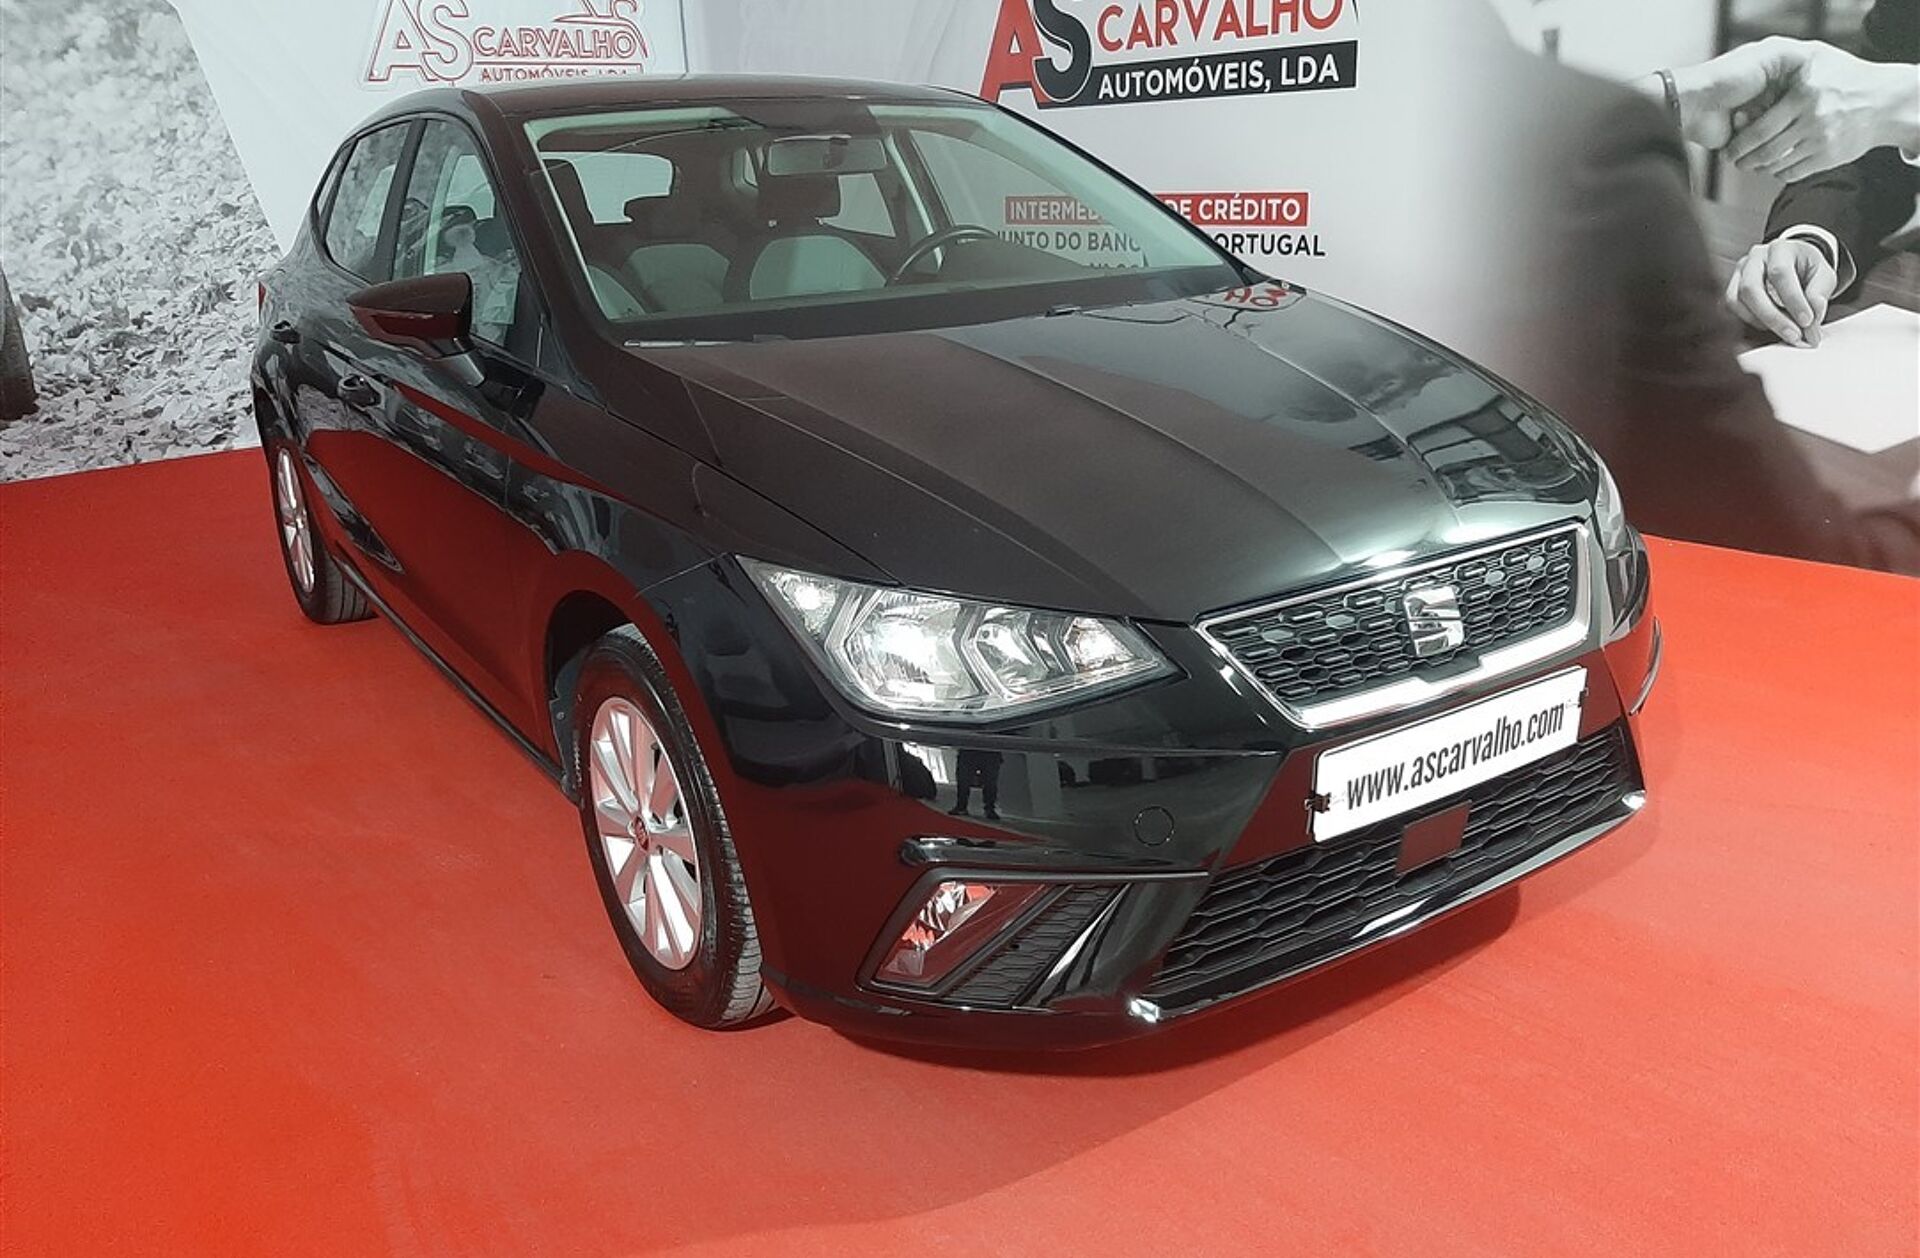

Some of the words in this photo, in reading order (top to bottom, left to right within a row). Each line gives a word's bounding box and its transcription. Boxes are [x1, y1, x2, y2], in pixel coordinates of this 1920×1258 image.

[369, 0, 473, 81] AS
[473, 27, 637, 58] CARVALHO
[980, 0, 1091, 103] AS
[1097, 0, 1343, 51] CARVALHO
[1098, 58, 1271, 99] AUTOMÓVEIS,
[1281, 53, 1340, 86] LDA
[1198, 193, 1300, 221] CRÉDITO
[1055, 231, 1082, 250] DO
[1088, 232, 1141, 252] BANC
[1213, 233, 1326, 256] ORTUGAL
[1346, 702, 1565, 811] www.ascarvalho.com
